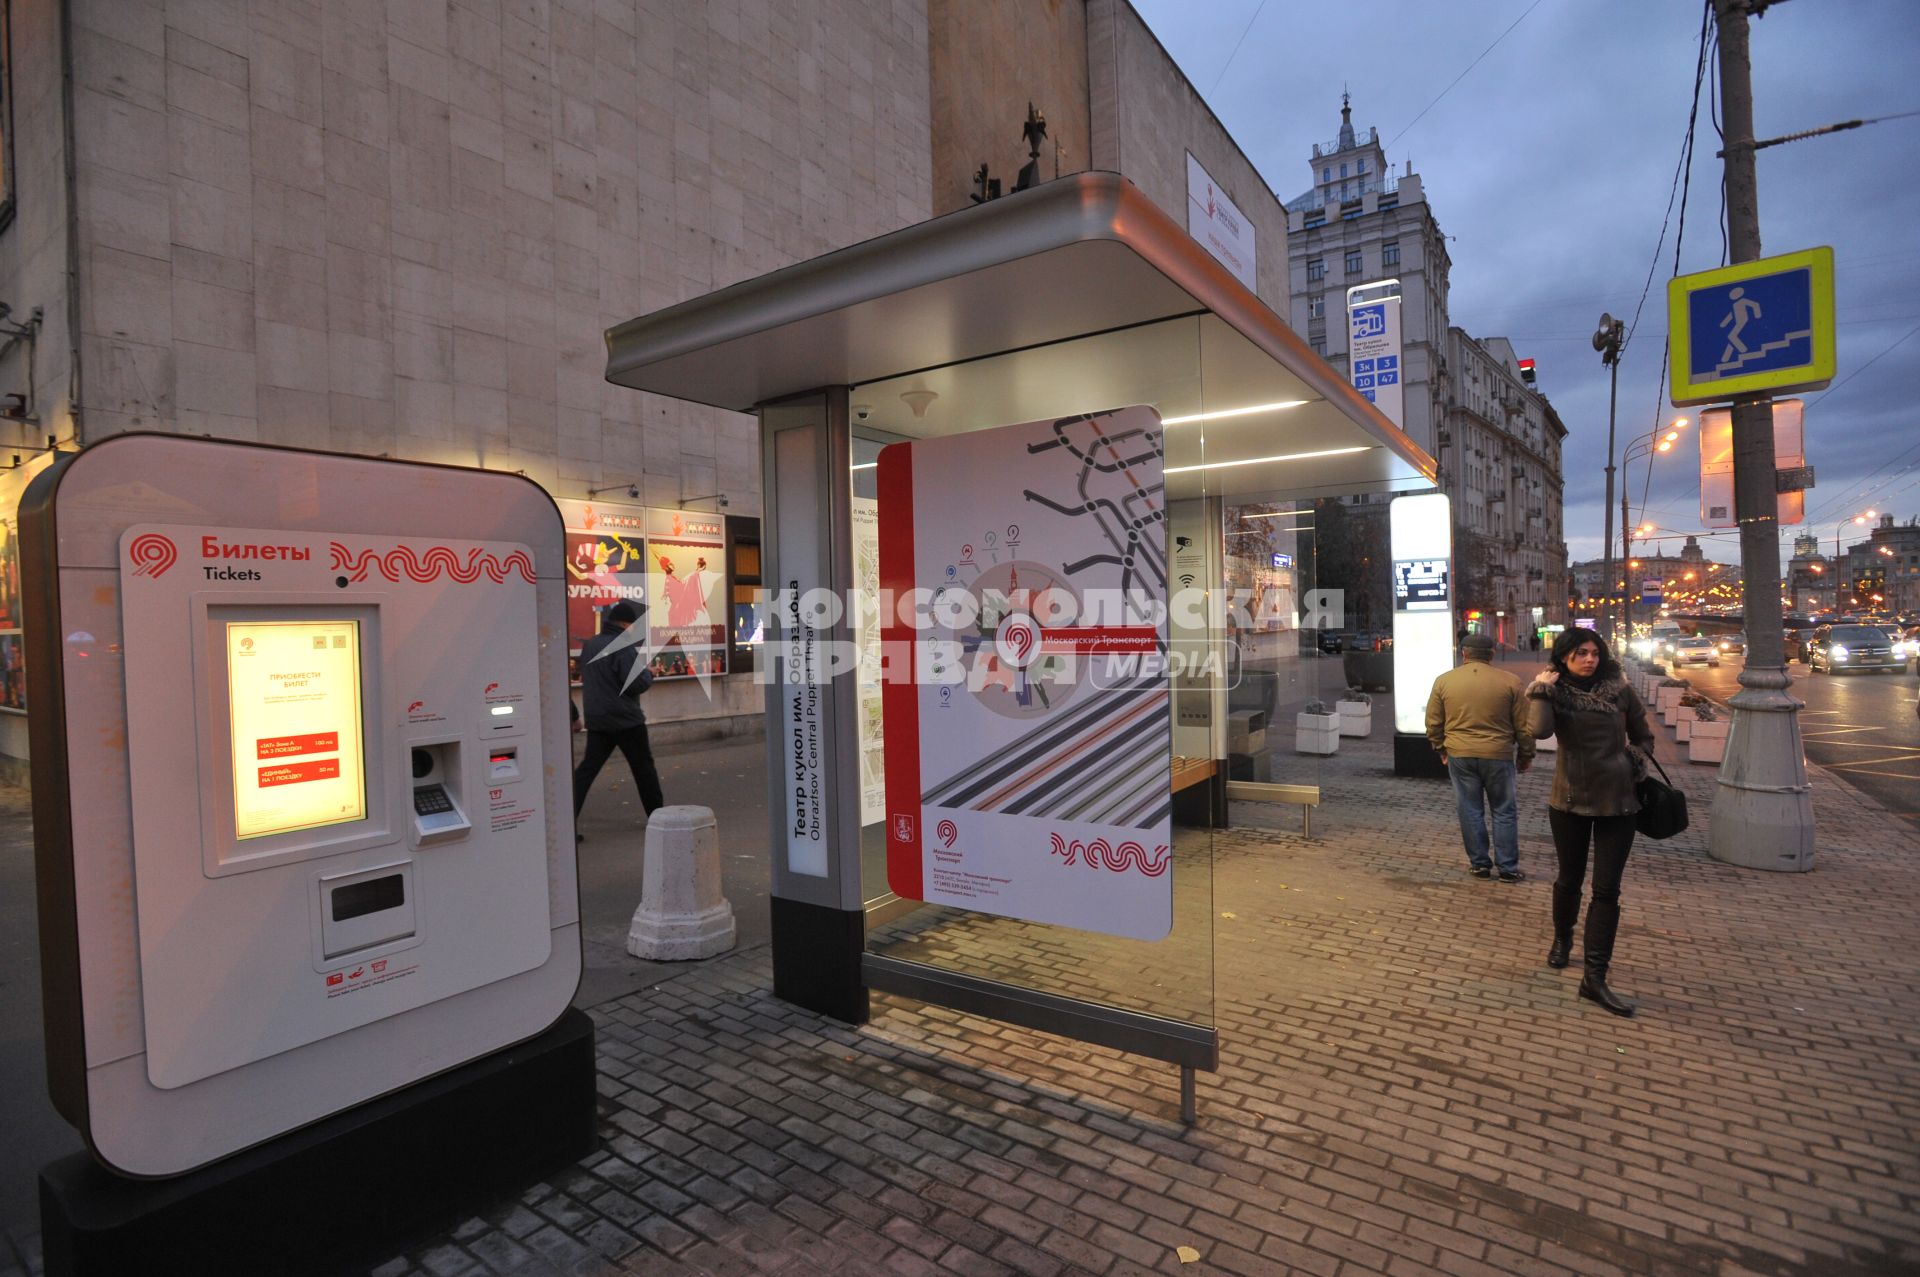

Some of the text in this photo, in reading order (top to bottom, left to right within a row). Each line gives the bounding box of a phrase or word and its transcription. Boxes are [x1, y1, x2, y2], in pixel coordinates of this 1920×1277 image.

[1360, 363, 1370, 371] 3к
[1360, 378, 1370, 386] 10
[202, 536, 310, 560] Билеты
[203, 566, 261, 580] Tickets
[567, 584, 644, 599] УРАТИНО
[1045, 635, 1151, 646] Московский Транспорт
[270, 672, 321, 681] ПРИОБРЕСТИ
[284, 680, 308, 688] БИЛЕТ
[789, 580, 807, 838] Театр кукол им. Образцова
[804, 611, 820, 840] Obraztsov Central Puppet Theatre
